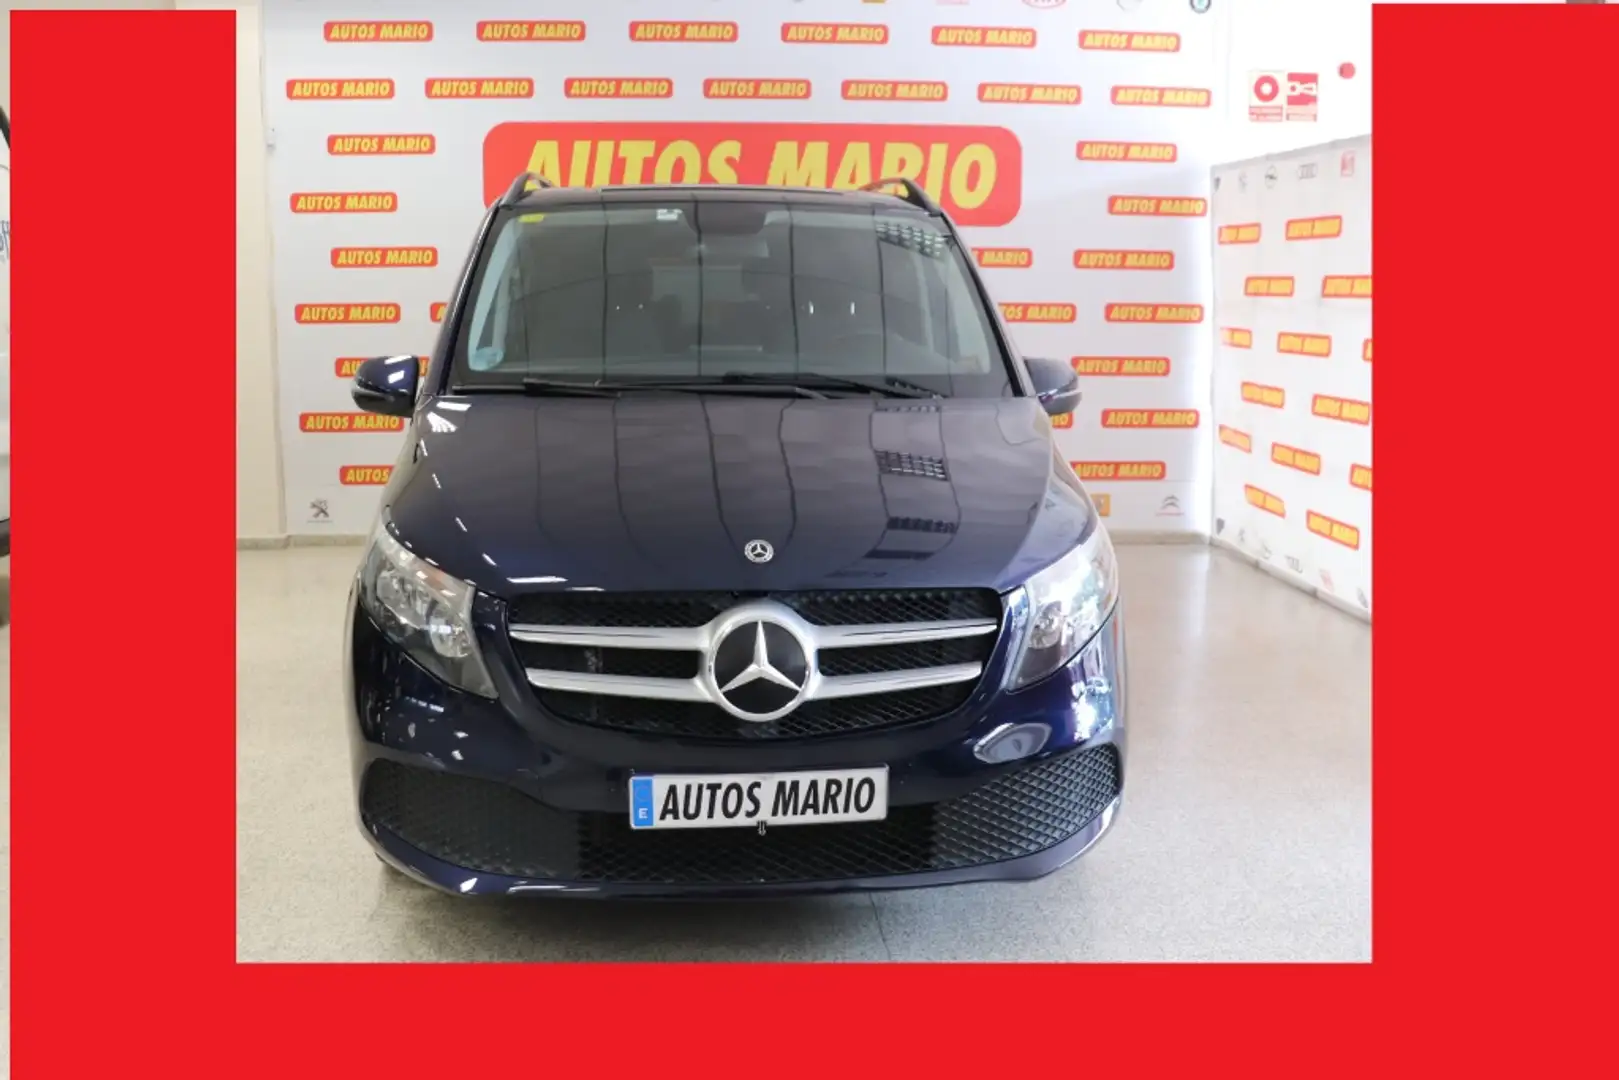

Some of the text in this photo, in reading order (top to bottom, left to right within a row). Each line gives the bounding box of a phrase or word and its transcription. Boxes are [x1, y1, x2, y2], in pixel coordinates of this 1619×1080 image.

[330, 24, 428, 39] AUTOS MARIO
[483, 24, 580, 39] AUTOS MARIO
[636, 24, 733, 40] AUTOS MARIO
[787, 25, 884, 42] AUTOS MARIO
[937, 27, 1033, 45] AUTOS MARIO
[1084, 33, 1177, 50] AUTOS MARIO
[293, 81, 390, 97] AUTOS MARIO
[431, 80, 529, 96] AUTOS MARIO
[571, 80, 668, 96] AUTOS MARIO
[710, 81, 807, 97] AUTOS MARIO
[847, 83, 944, 99] AUTOS MARIO
[983, 85, 1078, 103] AUTOS MARIO
[1116, 89, 1208, 106] AUTOS MARIO
[334, 136, 431, 153] AUTOS MARIO
[1082, 143, 1173, 160] AUTOS MARIO
[525, 140, 996, 208] AUTOS MARIO
[297, 194, 393, 211] AUTOS MARIO
[1114, 198, 1204, 215] AUTOS MARIO
[337, 249, 433, 265] AUTOS MARIO
[982, 250, 1029, 265] MARIO
[1079, 252, 1170, 268] AUTOS MARIO
[302, 305, 396, 321] AUTOS MARIO
[1027, 305, 1072, 320] MARIO
[1110, 305, 1201, 320] AUTOS MARIO
[1076, 359, 1167, 374] AUTOS MARIO
[306, 415, 401, 429] AUTOS MARIO
[1107, 411, 1196, 426] AUTOS MARIO
[346, 468, 390, 483] AUTOS
[1118, 463, 1162, 477] MARIO
[659, 776, 876, 821] AUTOS MARIO
[638, 808, 649, 819] E
